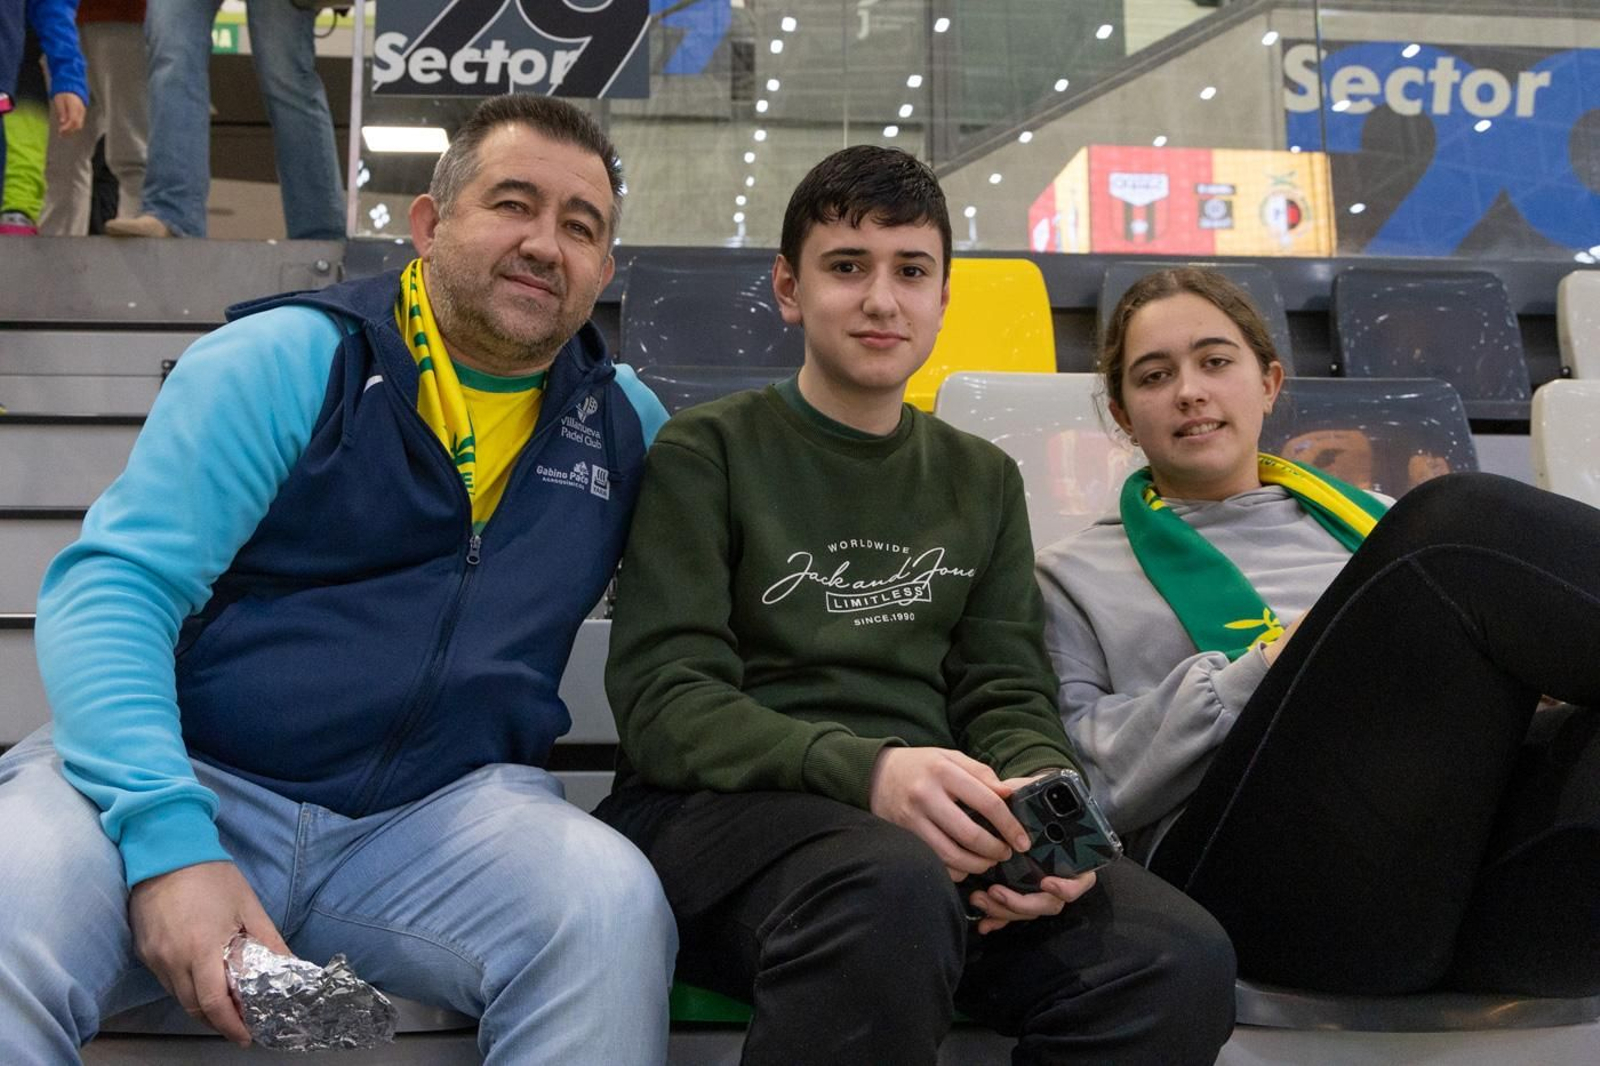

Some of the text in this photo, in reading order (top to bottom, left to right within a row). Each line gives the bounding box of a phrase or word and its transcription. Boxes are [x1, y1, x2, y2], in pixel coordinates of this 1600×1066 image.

[373, 31, 579, 85] Sector
[1283, 43, 1552, 118] Sector
[561, 416, 601, 439] Villanueva
[561, 427, 602, 449] Padel Club
[536, 465, 568, 479] Gabino
[827, 539, 910, 554] WORLDWIDE
[761, 551, 851, 604] Jack
[852, 557, 912, 589] and
[834, 587, 923, 608] LIMITLESS
[854, 613, 915, 626] SINCE.1990
